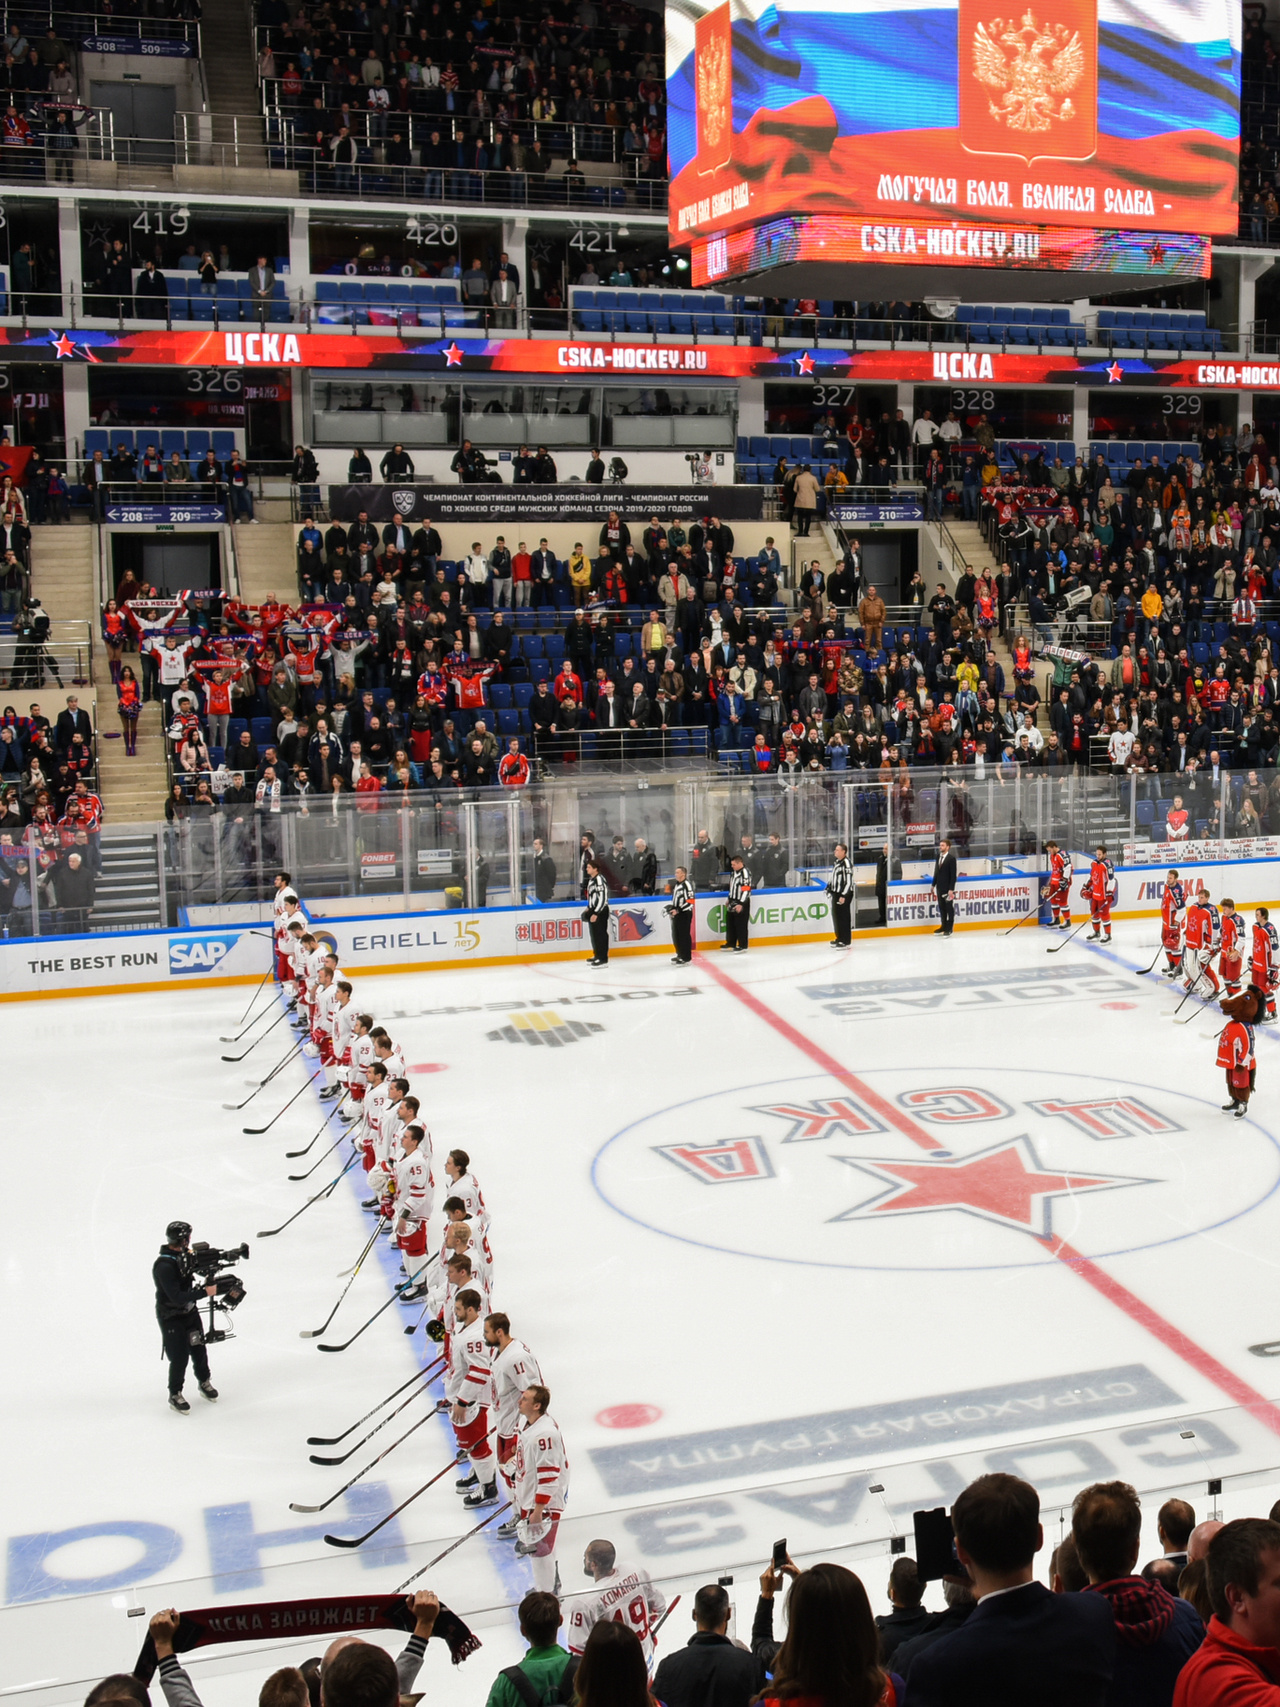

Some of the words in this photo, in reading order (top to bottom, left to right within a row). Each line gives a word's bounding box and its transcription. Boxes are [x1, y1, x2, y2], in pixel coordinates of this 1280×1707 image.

[96, 42, 116, 51] 508
[141, 44, 160, 54] 509
[877, 174, 957, 204] МОГУЧАЯ
[1022, 183, 1095, 212] ВЕЛИКАЯ
[1103, 188, 1155, 215] СЛАВА
[132, 211, 189, 236] 419
[406, 222, 458, 246] 420
[569, 229, 617, 253] 421
[860, 224, 1041, 259] CSKA-HOCKEY.RU
[225, 332, 301, 364] ЦСКА
[557, 346, 708, 371] CSKA-HOCKEY.RU
[932, 352, 994, 381] ЦСКА
[187, 369, 242, 393] 326
[812, 385, 856, 407] 327
[952, 390, 996, 411] 328
[1162, 394, 1202, 416] 329
[423, 494, 473, 502] ЧЕМПИОНАТ
[475, 493, 553, 502] КОНТИНЕНТАЛЬНОЙ
[555, 493, 601, 502] ХОККЕЙНОЙ
[602, 494, 623, 502] ЛИГИ
[122, 512, 143, 522] 208
[170, 511, 191, 522] 209
[490, 505, 516, 513] СРЕДИ
[559, 505, 593, 513] КОМАНД
[625, 505, 666, 513] 2019/2020
[840, 511, 858, 520] 209
[879, 511, 896, 520] 210
[907, 824, 934, 832] FONBET
[361, 854, 395, 863] FONBET
[1007, 886, 1030, 897] МАТЧ:
[750, 902, 829, 926] МЕГАФ
[352, 931, 448, 951] ERIELL
[454, 919, 481, 951] 15
[516, 918, 583, 944] #ЦВБП
[454, 938, 474, 948] лет
[28, 960, 67, 975] THE
[70, 955, 116, 971] BEST
[121, 952, 159, 967] RUN
[169, 942, 229, 969] SAP
[821, 978, 1144, 1016] СОГАЗ
[360, 1046, 370, 1055] 25
[374, 1097, 385, 1107] 53
[650, 1086, 1187, 1185] ЦСКА
[410, 1165, 422, 1175] 45
[467, 1341, 483, 1354] 59
[514, 1362, 526, 1376] 11
[852, 1379, 1139, 1438] СТРАХОВАЯ
[539, 1436, 553, 1451] 91
[628, 1419, 848, 1475] ГРУППА
[600, 1572, 640, 1609] KOMAROV
[208, 1613, 264, 1634] ЦСКА
[270, 1605, 381, 1630] ЗАРЯЖАЕТ
[570, 1611, 583, 1627] 19
